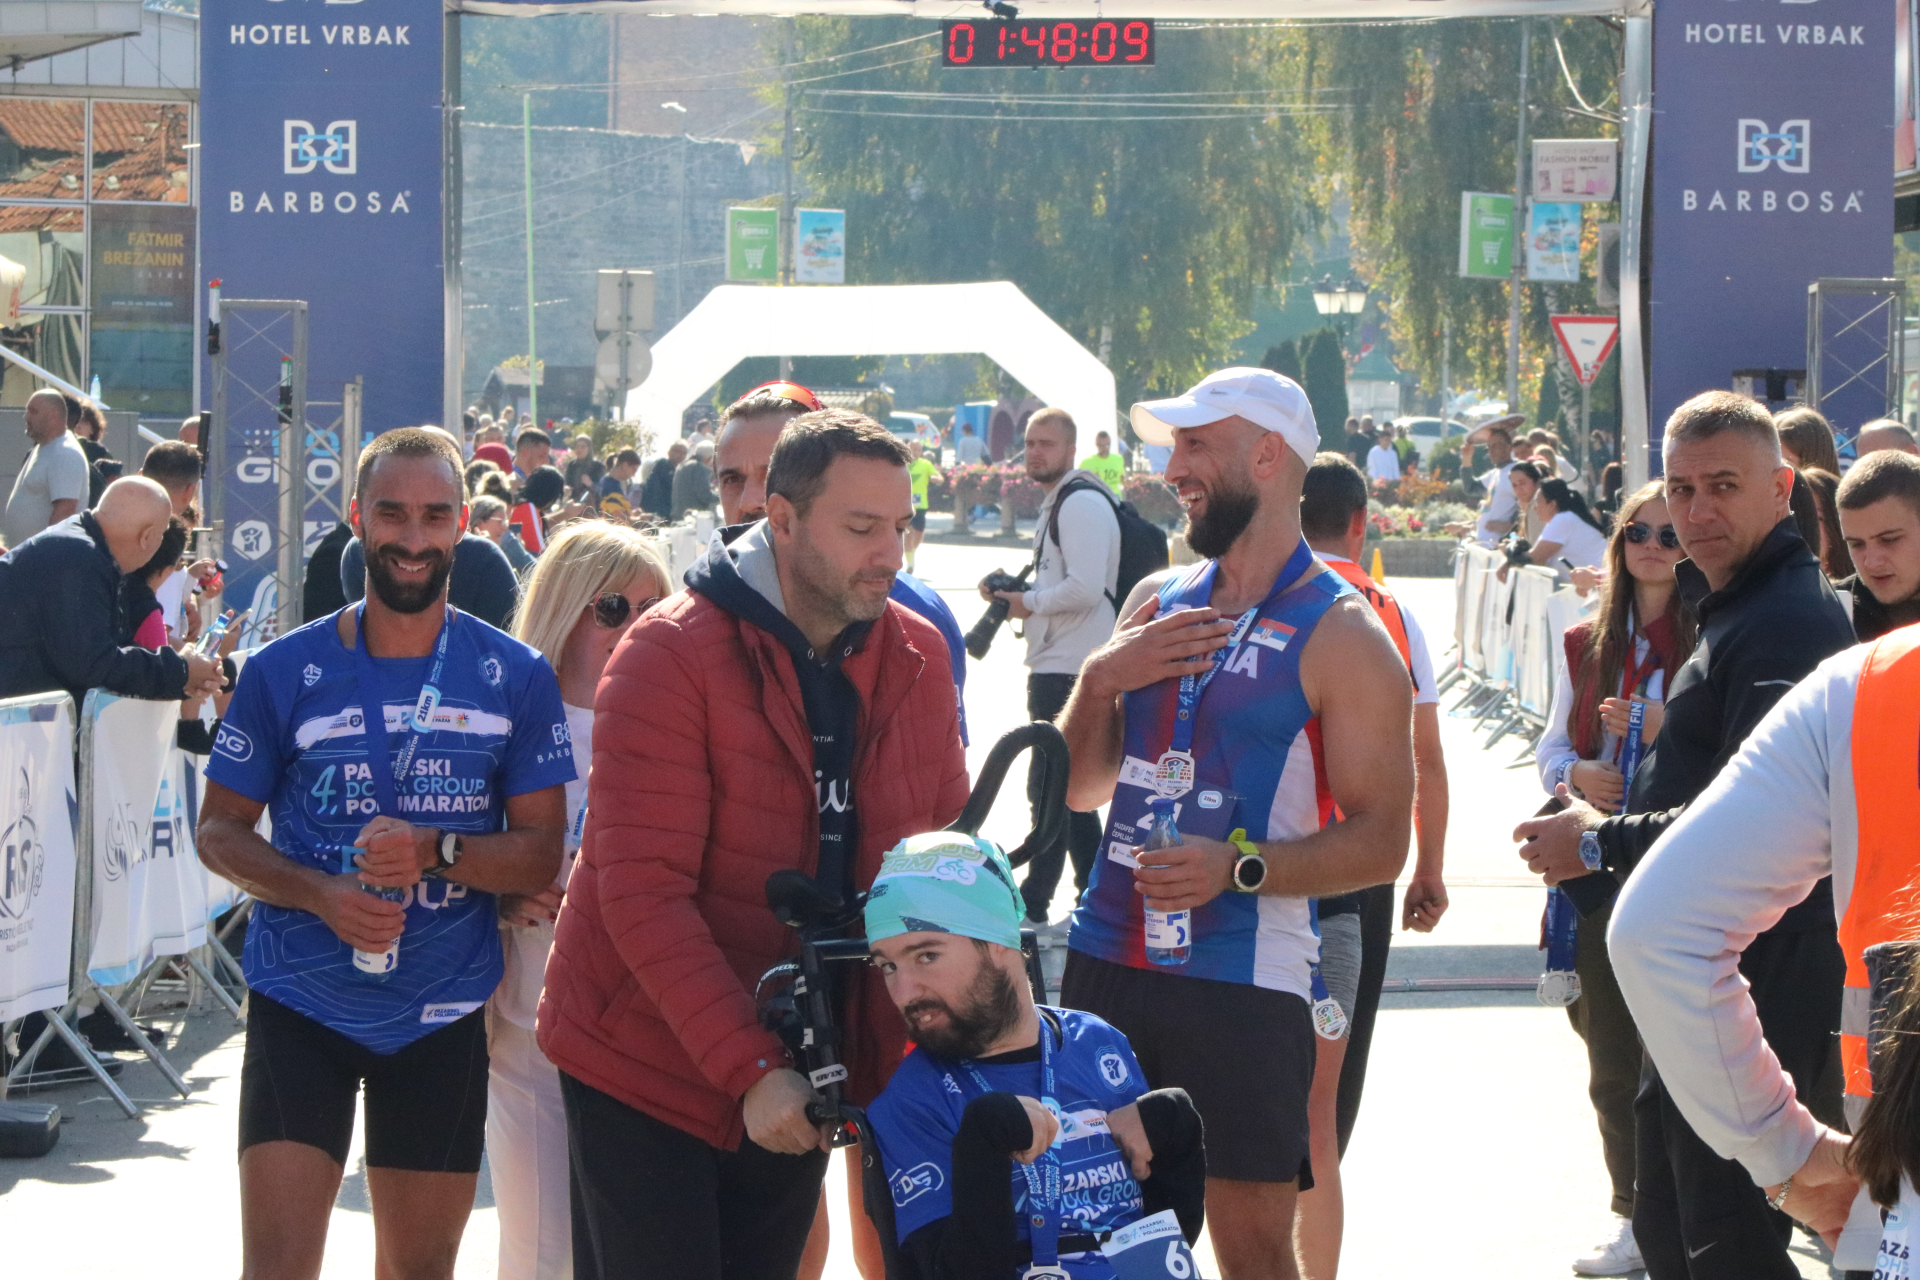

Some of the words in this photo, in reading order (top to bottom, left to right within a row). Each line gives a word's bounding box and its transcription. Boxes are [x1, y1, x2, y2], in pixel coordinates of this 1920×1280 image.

[230, 24, 311, 45] HOTEL
[321, 25, 410, 45] VRBAK
[1685, 23, 1766, 44] HOTEL
[1776, 24, 1865, 45] VRBAK
[1539, 155, 1576, 164] FASHION
[1578, 155, 1610, 164] MOBILE
[127, 232, 184, 247] FATMIR
[103, 249, 184, 267] BREŽANIN
[417, 694, 433, 723] 21km
[400, 734, 420, 781] POLUMARATON
[413, 777, 486, 795] GROUP
[1139, 1219, 1165, 1231] PAZARSKI
